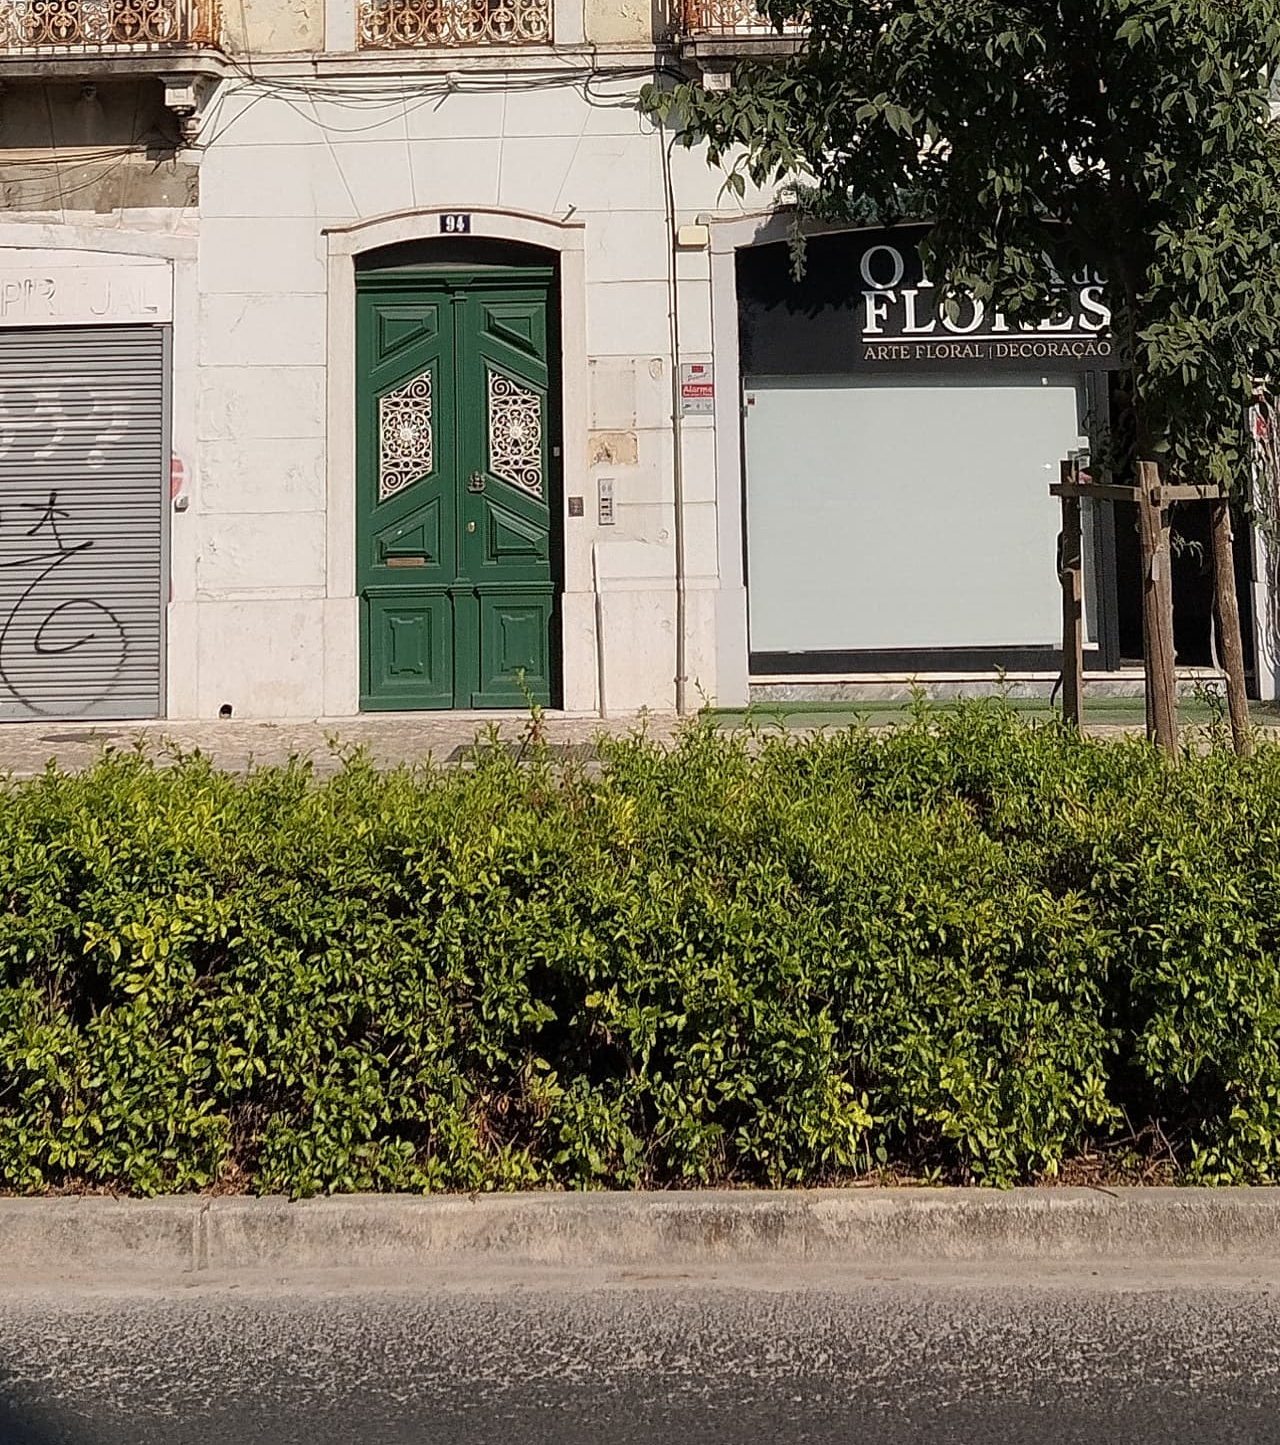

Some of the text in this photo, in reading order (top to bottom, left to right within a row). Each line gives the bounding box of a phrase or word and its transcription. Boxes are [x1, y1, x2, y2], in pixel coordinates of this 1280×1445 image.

[446, 215, 465, 232] 94
[860, 245, 904, 290] O
[861, 286, 1112, 334] FLOS
[863, 341, 1112, 360] ARTE FLORAL DECORAÇÃO
